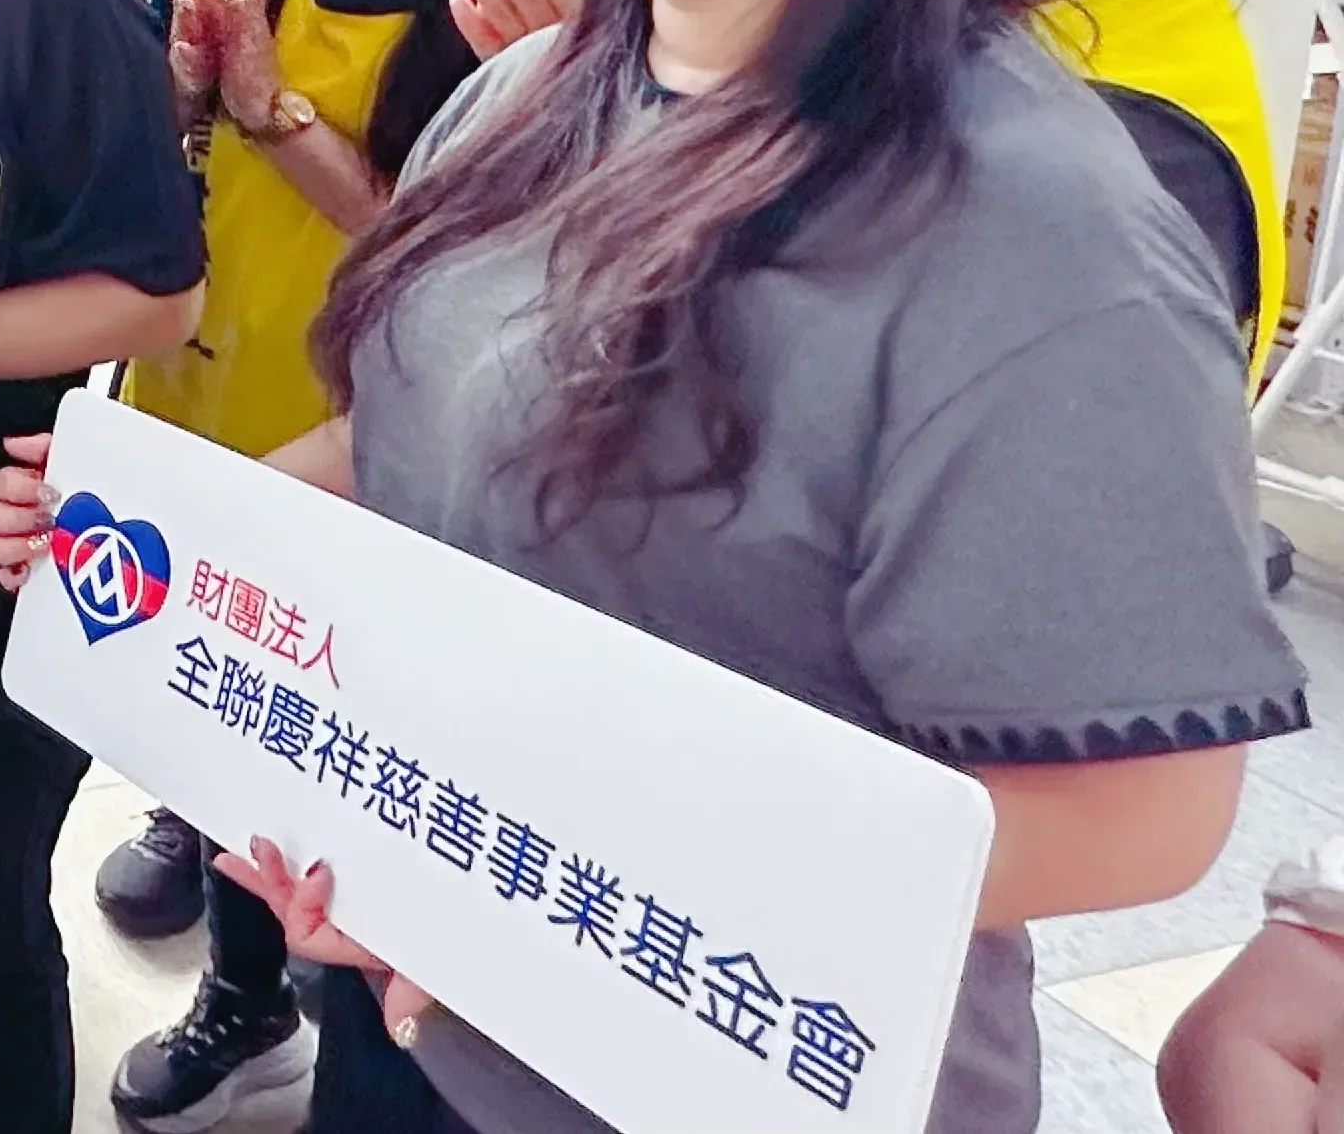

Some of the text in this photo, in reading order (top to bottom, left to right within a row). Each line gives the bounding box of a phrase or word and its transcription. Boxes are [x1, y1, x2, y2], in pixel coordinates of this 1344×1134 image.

[187, 557, 342, 690] 財團法人
[167, 636, 876, 1112] 全聯慶祥慈善事業基金會
